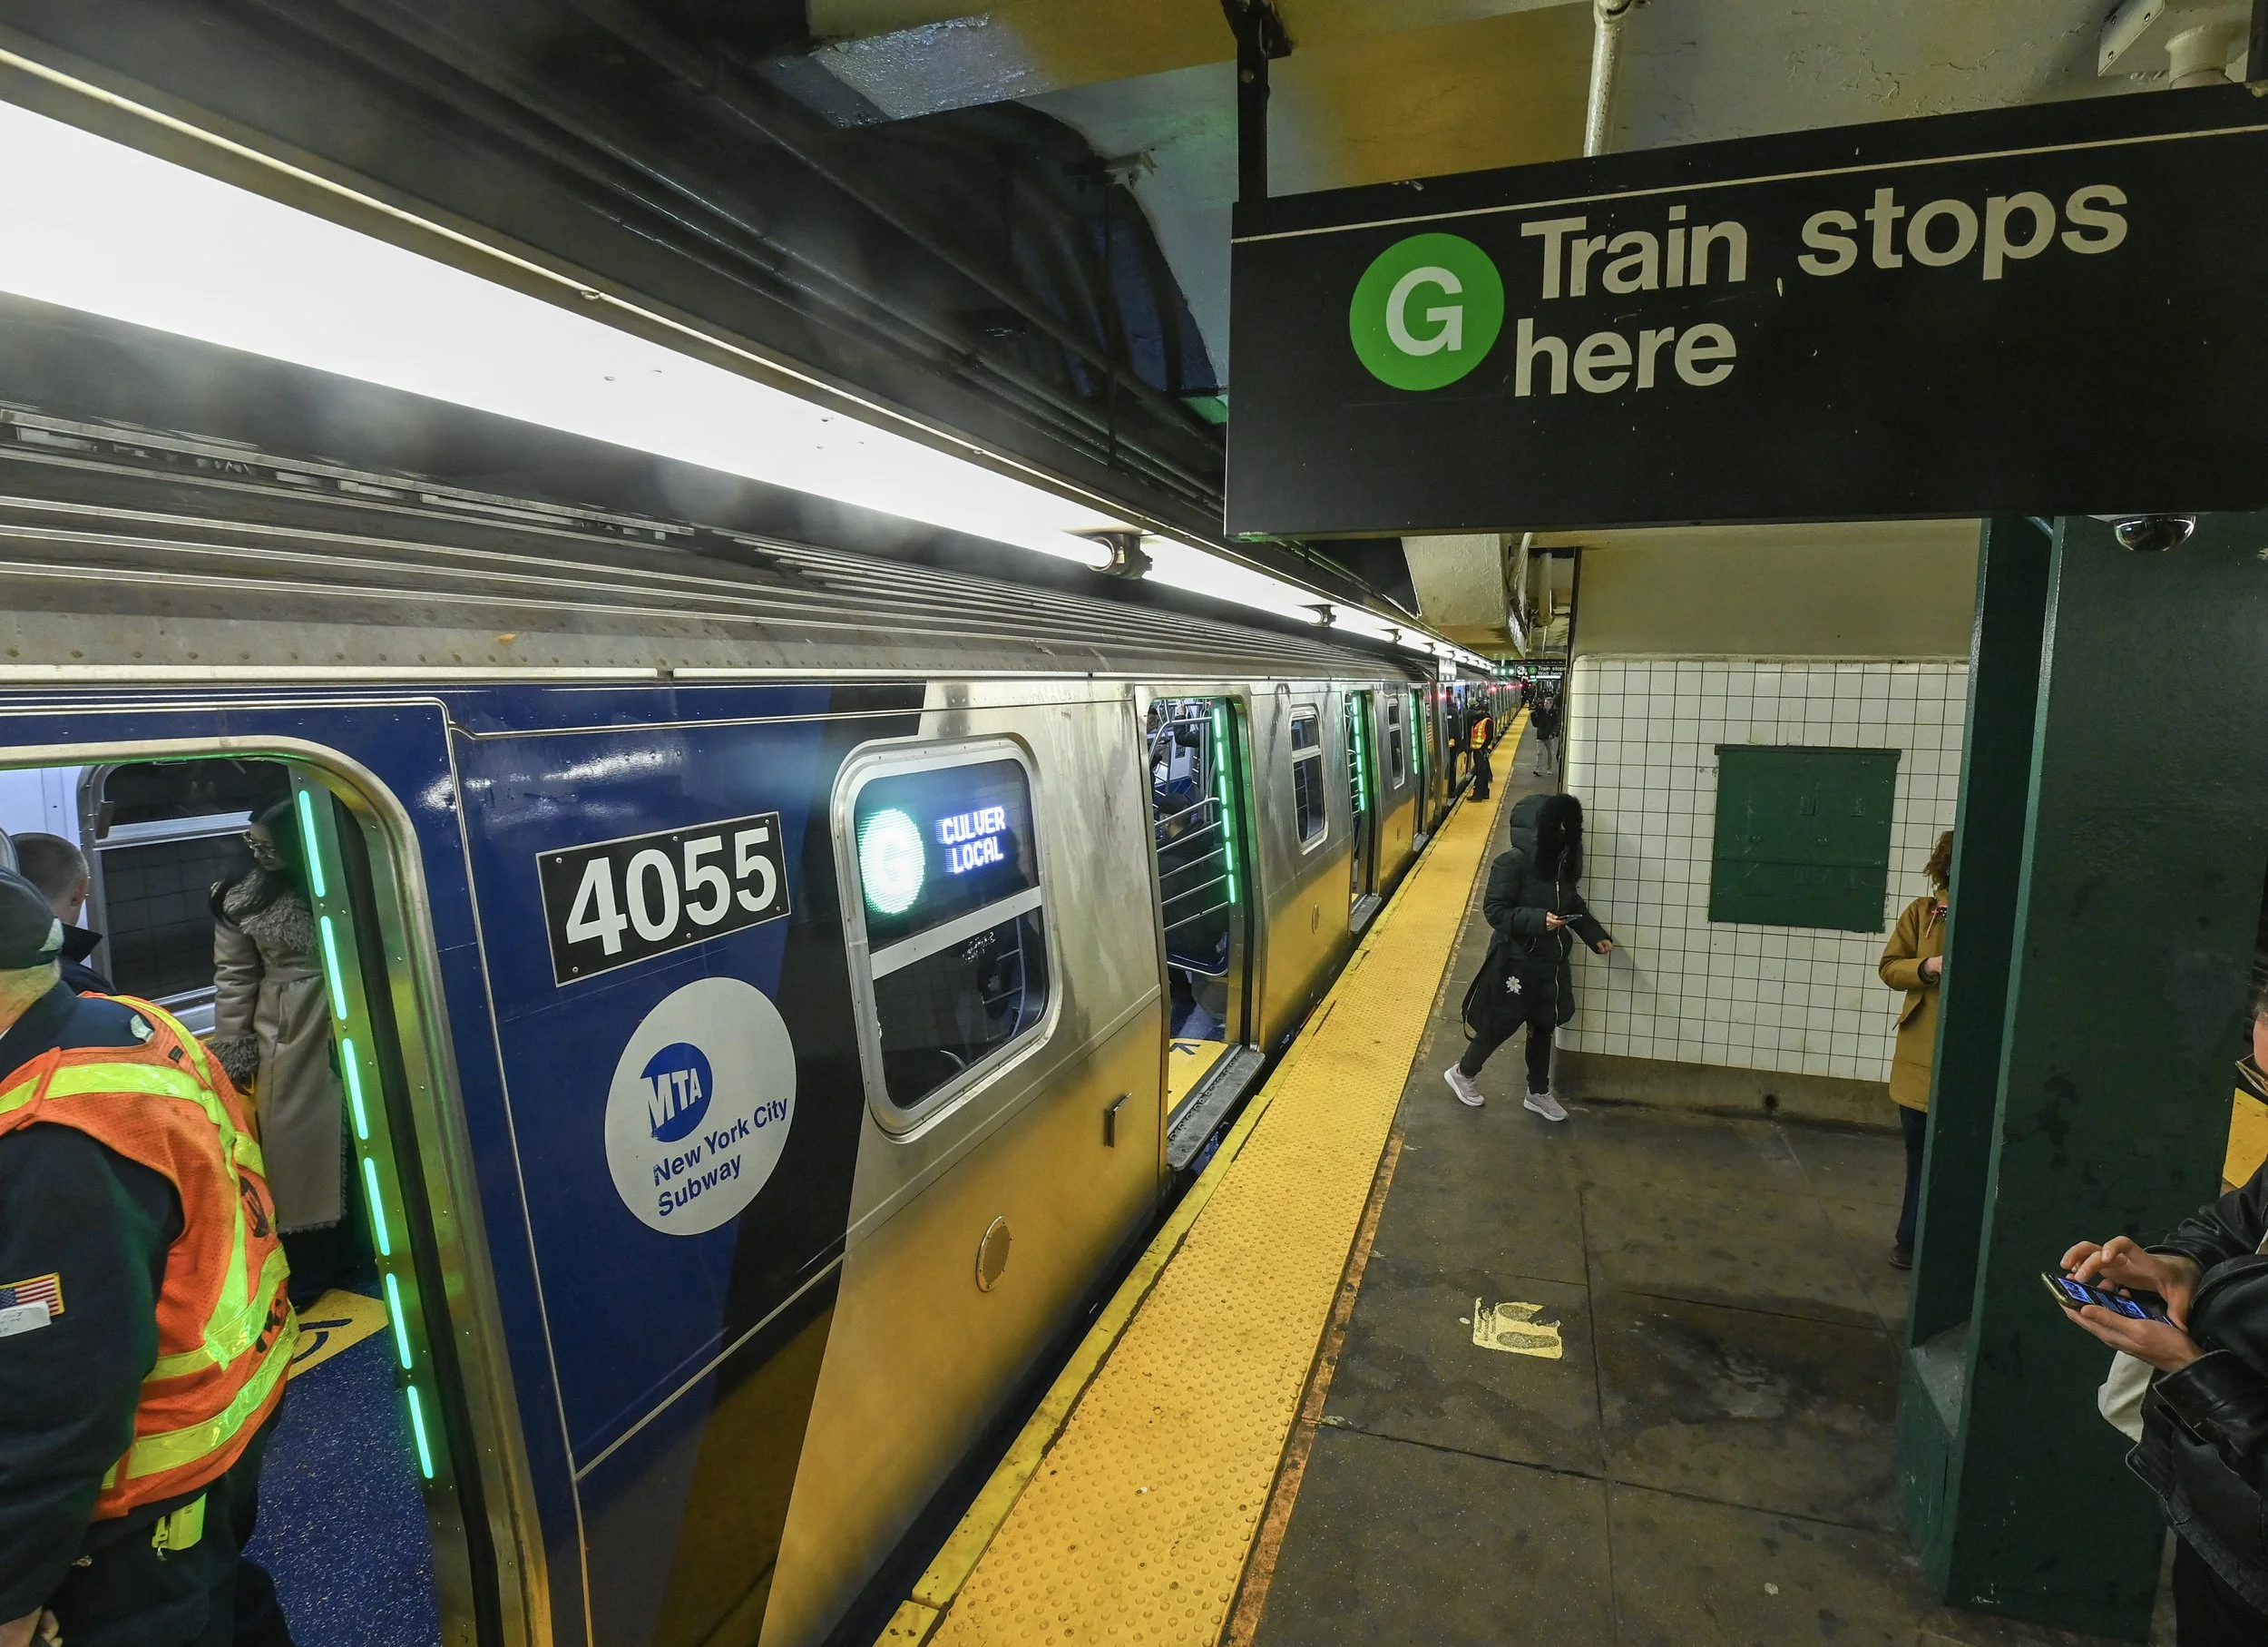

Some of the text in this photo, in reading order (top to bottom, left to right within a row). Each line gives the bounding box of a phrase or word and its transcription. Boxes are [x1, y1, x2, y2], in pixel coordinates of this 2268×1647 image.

[1385, 184, 2127, 357] G Train stops
[1514, 318, 1737, 397] here
[939, 806, 1006, 845] CULVER
[950, 836, 1004, 874] LOCAL
[565, 826, 777, 956] 4055
[640, 1067, 703, 1131] MTA
[653, 1098, 787, 1186] New York City
[658, 1154, 741, 1217] Subway
